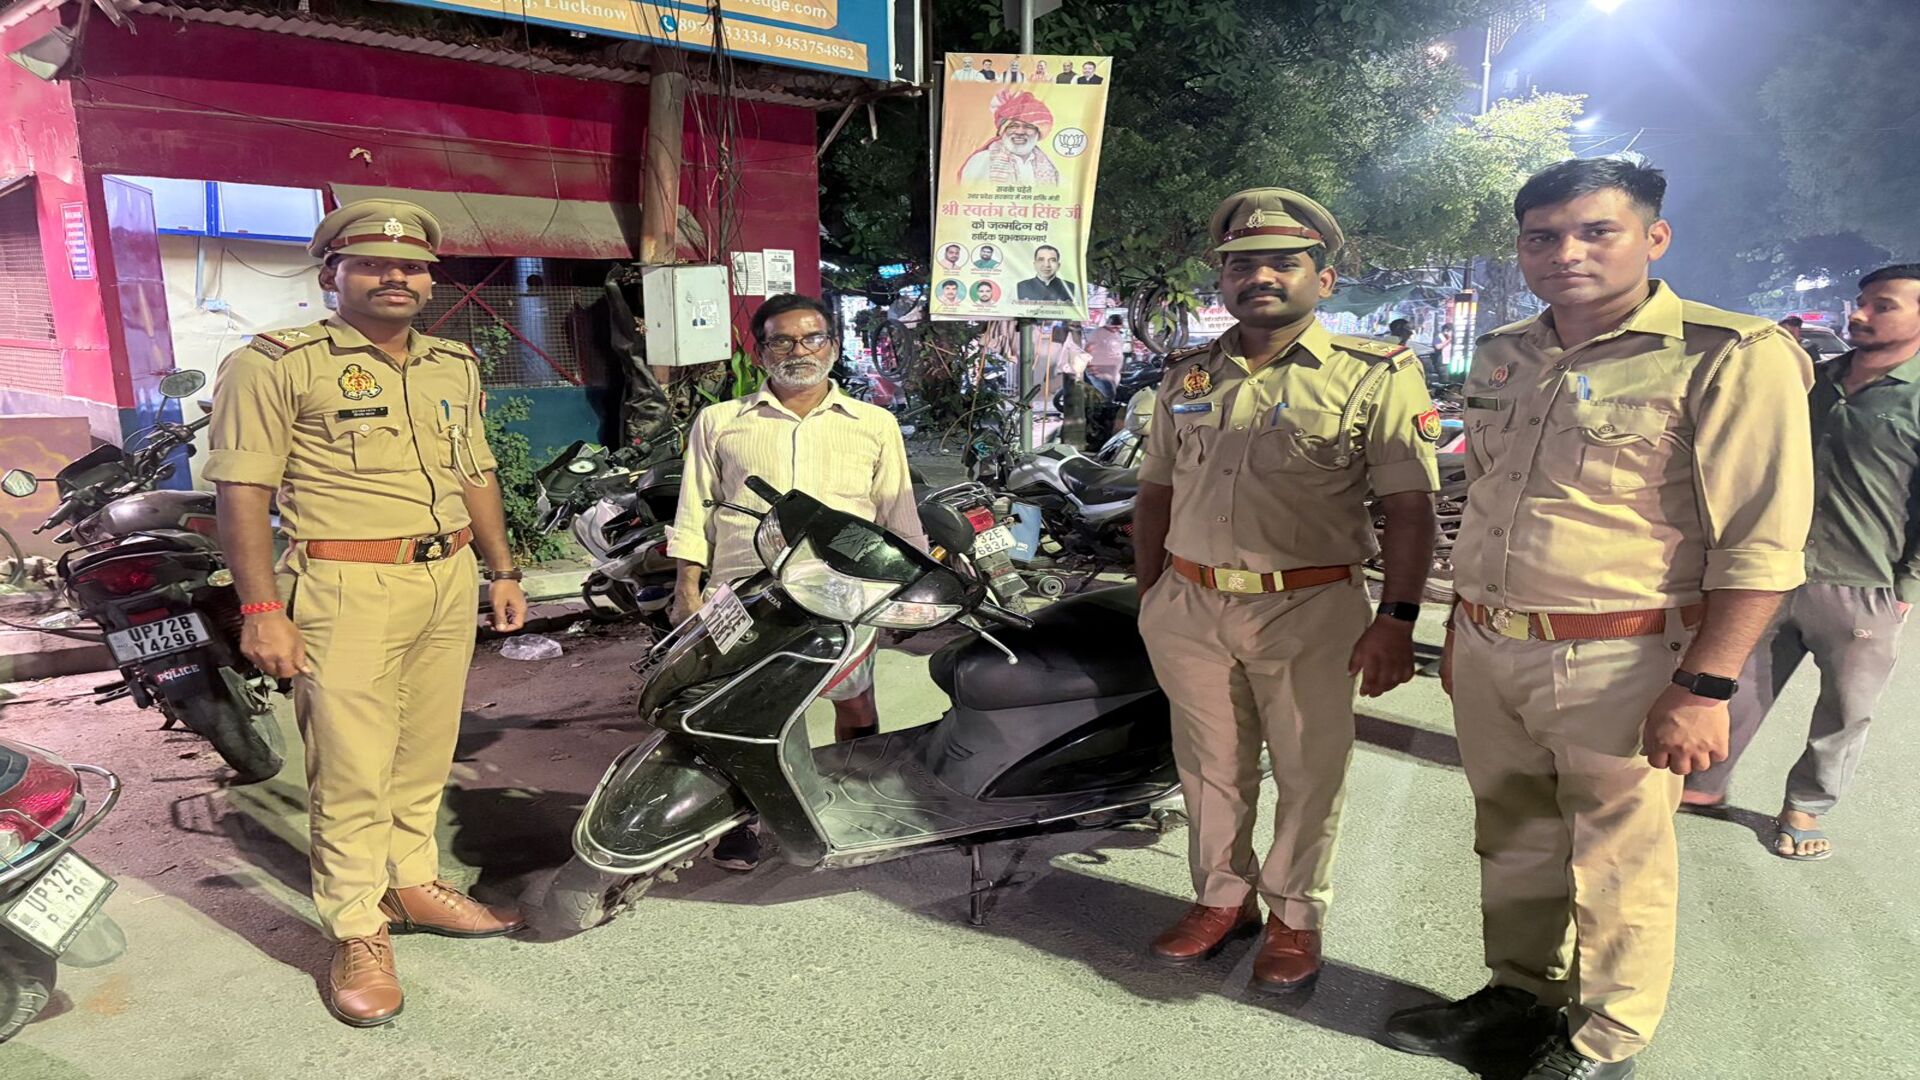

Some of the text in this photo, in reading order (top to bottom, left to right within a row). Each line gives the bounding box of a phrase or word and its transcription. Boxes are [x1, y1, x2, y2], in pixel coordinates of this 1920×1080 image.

[544, 0, 628, 20] Lucknow
[775, 34, 855, 60] 9453754852
[942, 202, 959, 216] श्री
[1007, 202, 1028, 218] देव
[1032, 203, 1061, 219] सिंह
[1065, 204, 1082, 219] जी
[971, 220, 1049, 231] को जन्मदिन की
[128, 616, 192, 642] UP72B
[134, 630, 198, 655] Y4296
[157, 664, 200, 682] POLICE
